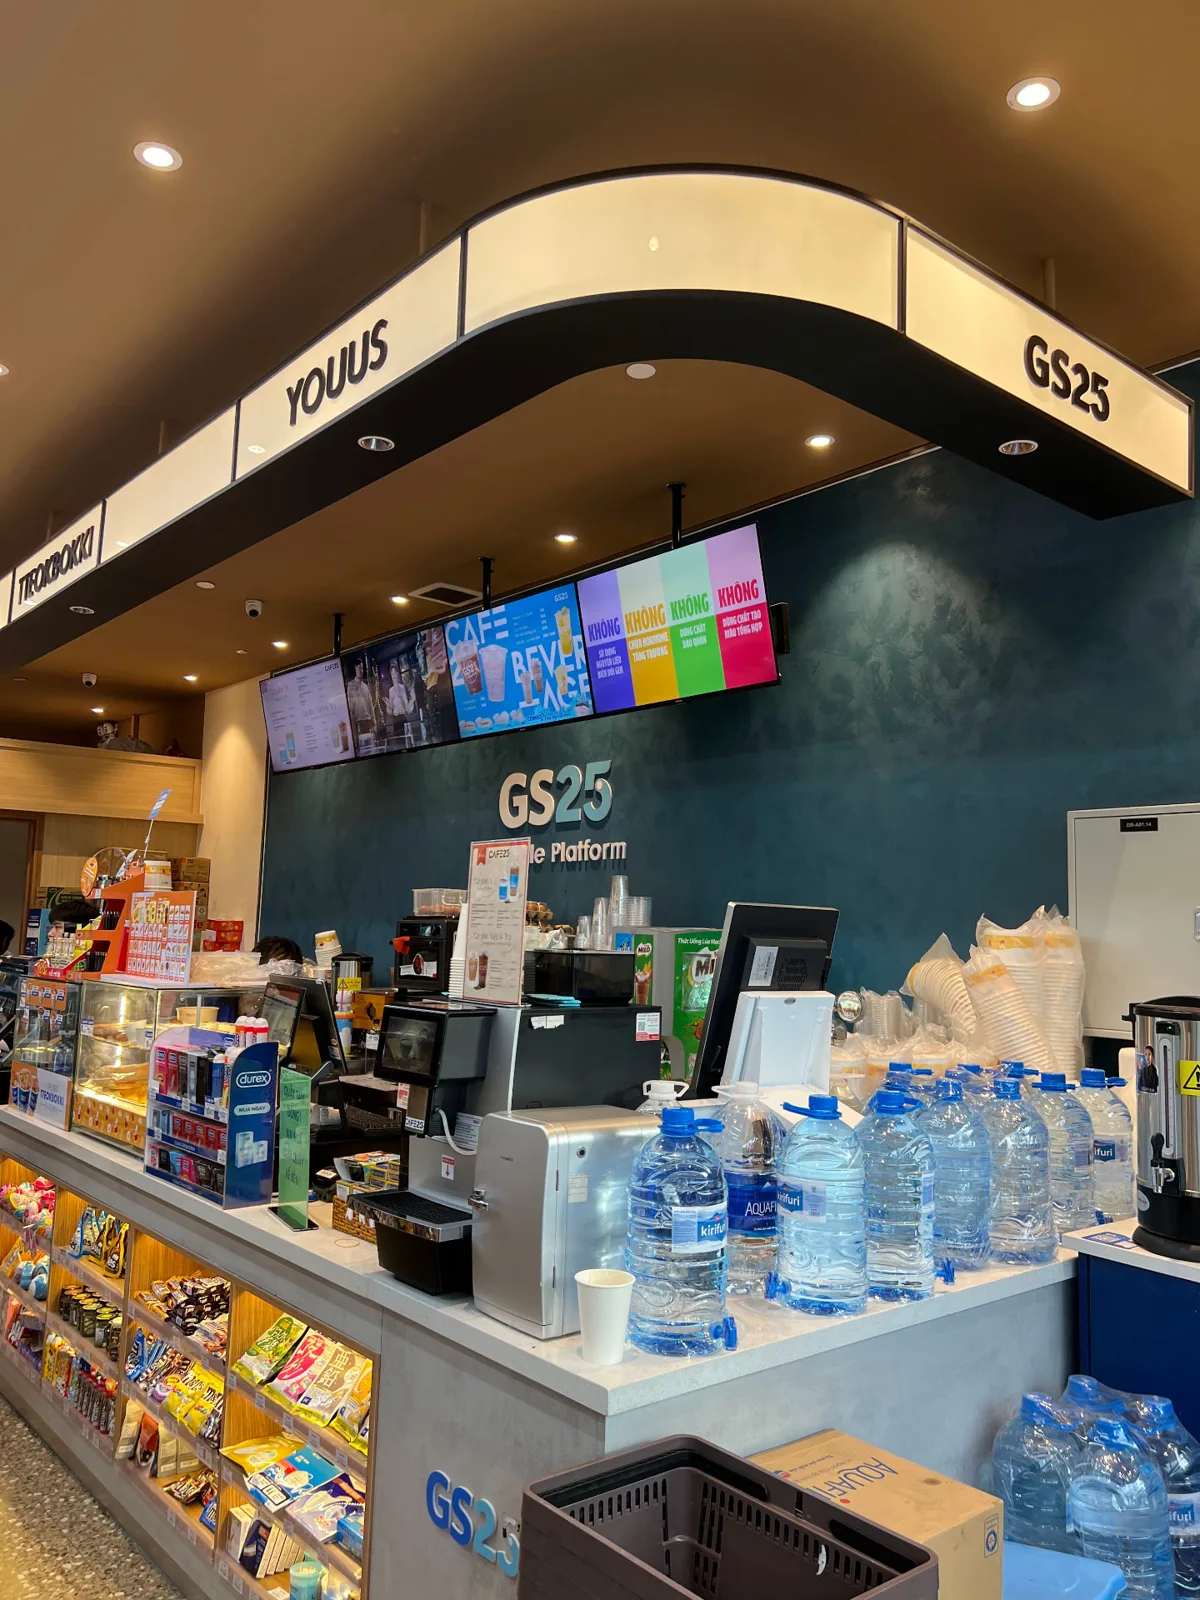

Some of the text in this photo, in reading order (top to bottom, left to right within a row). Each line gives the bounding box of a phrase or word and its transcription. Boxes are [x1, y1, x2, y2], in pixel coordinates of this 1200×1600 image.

[286, 318, 388, 427] YOUUS
[1023, 334, 1110, 422] GS25
[18, 525, 95, 605] TTEOKBOKKI
[670, 593, 710, 621] KHÔNG
[717, 578, 759, 608] KHÔNG
[588, 617, 621, 642] KHÔNG
[624, 604, 667, 634] KHÔNG
[499, 759, 614, 829] GS25
[488, 849, 510, 859] CAFE25
[551, 838, 627, 863] Platform
[239, 1073, 269, 1084] durex
[701, 1221, 726, 1237] kirifu
[318, 1349, 352, 1388] 亜鉛
